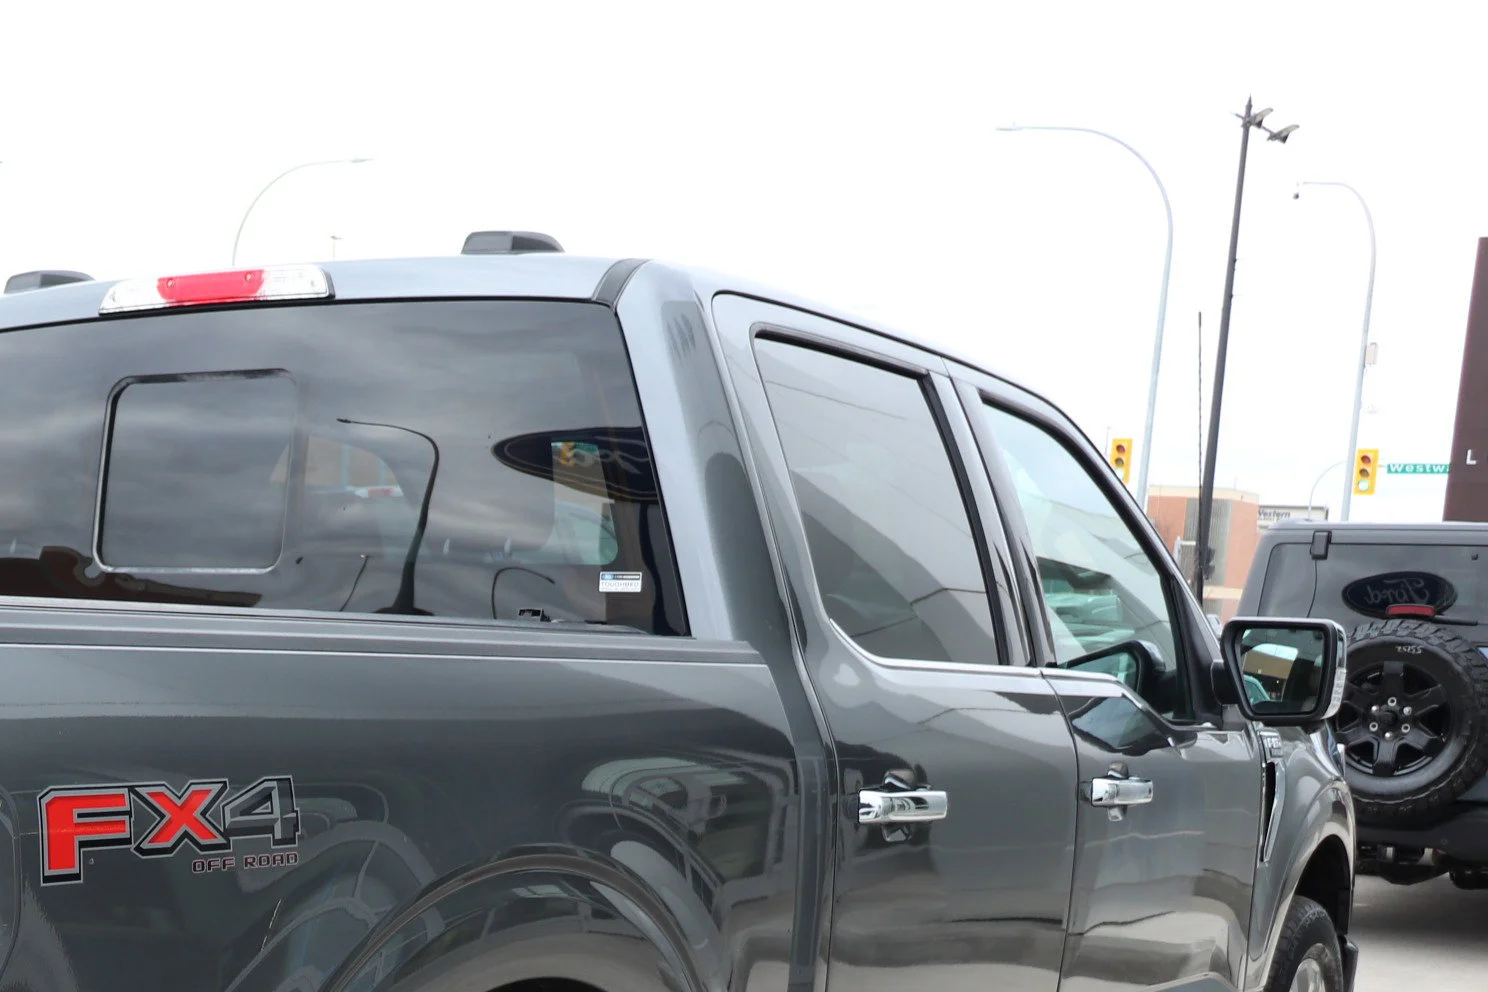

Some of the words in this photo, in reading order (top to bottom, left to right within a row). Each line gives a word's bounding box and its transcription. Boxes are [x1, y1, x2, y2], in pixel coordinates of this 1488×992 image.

[1389, 463, 1450, 473] Westw
[37, 775, 300, 887] FX4
[192, 856, 236, 874] OFF
[243, 851, 300, 871] ROAD
